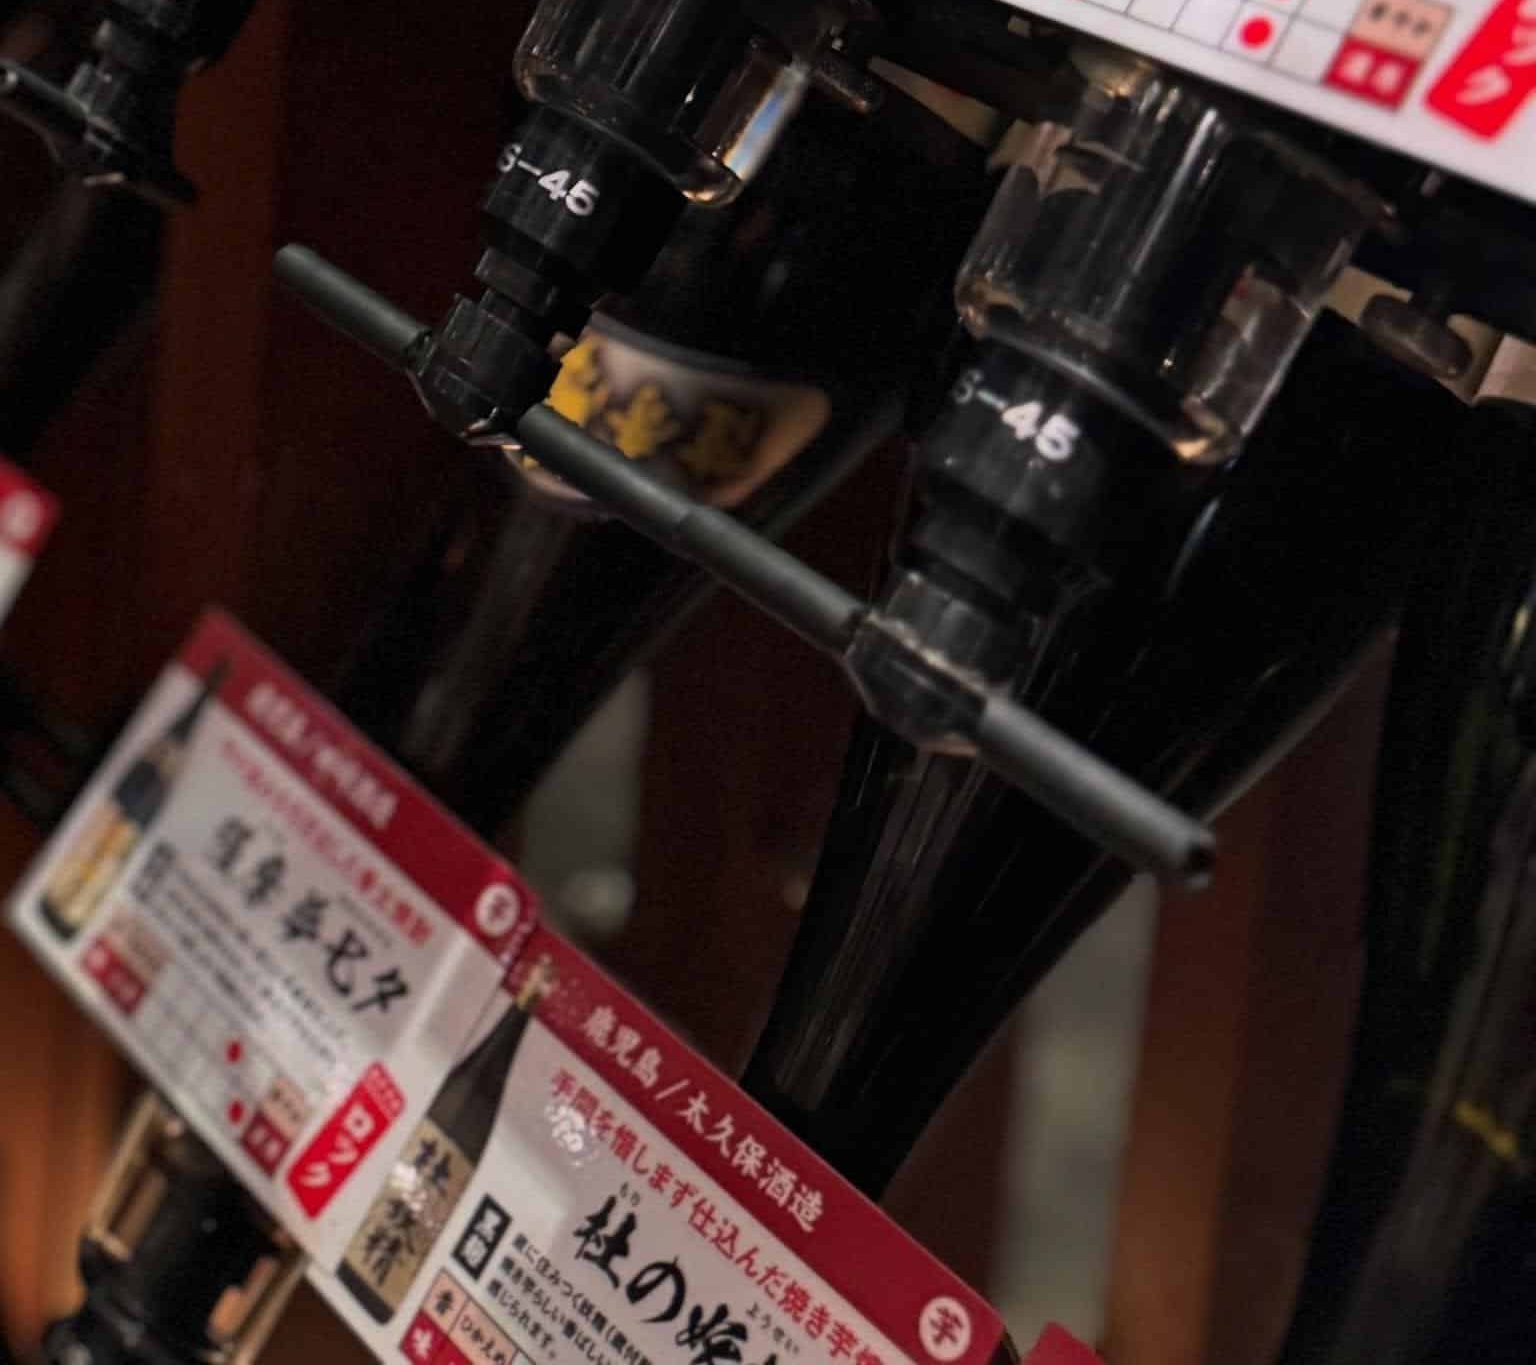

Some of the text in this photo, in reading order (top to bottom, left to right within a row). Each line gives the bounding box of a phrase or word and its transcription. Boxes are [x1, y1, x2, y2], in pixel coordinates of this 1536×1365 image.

[300, 1105, 376, 1189] ロック
[928, 1306, 963, 1346] 芋
